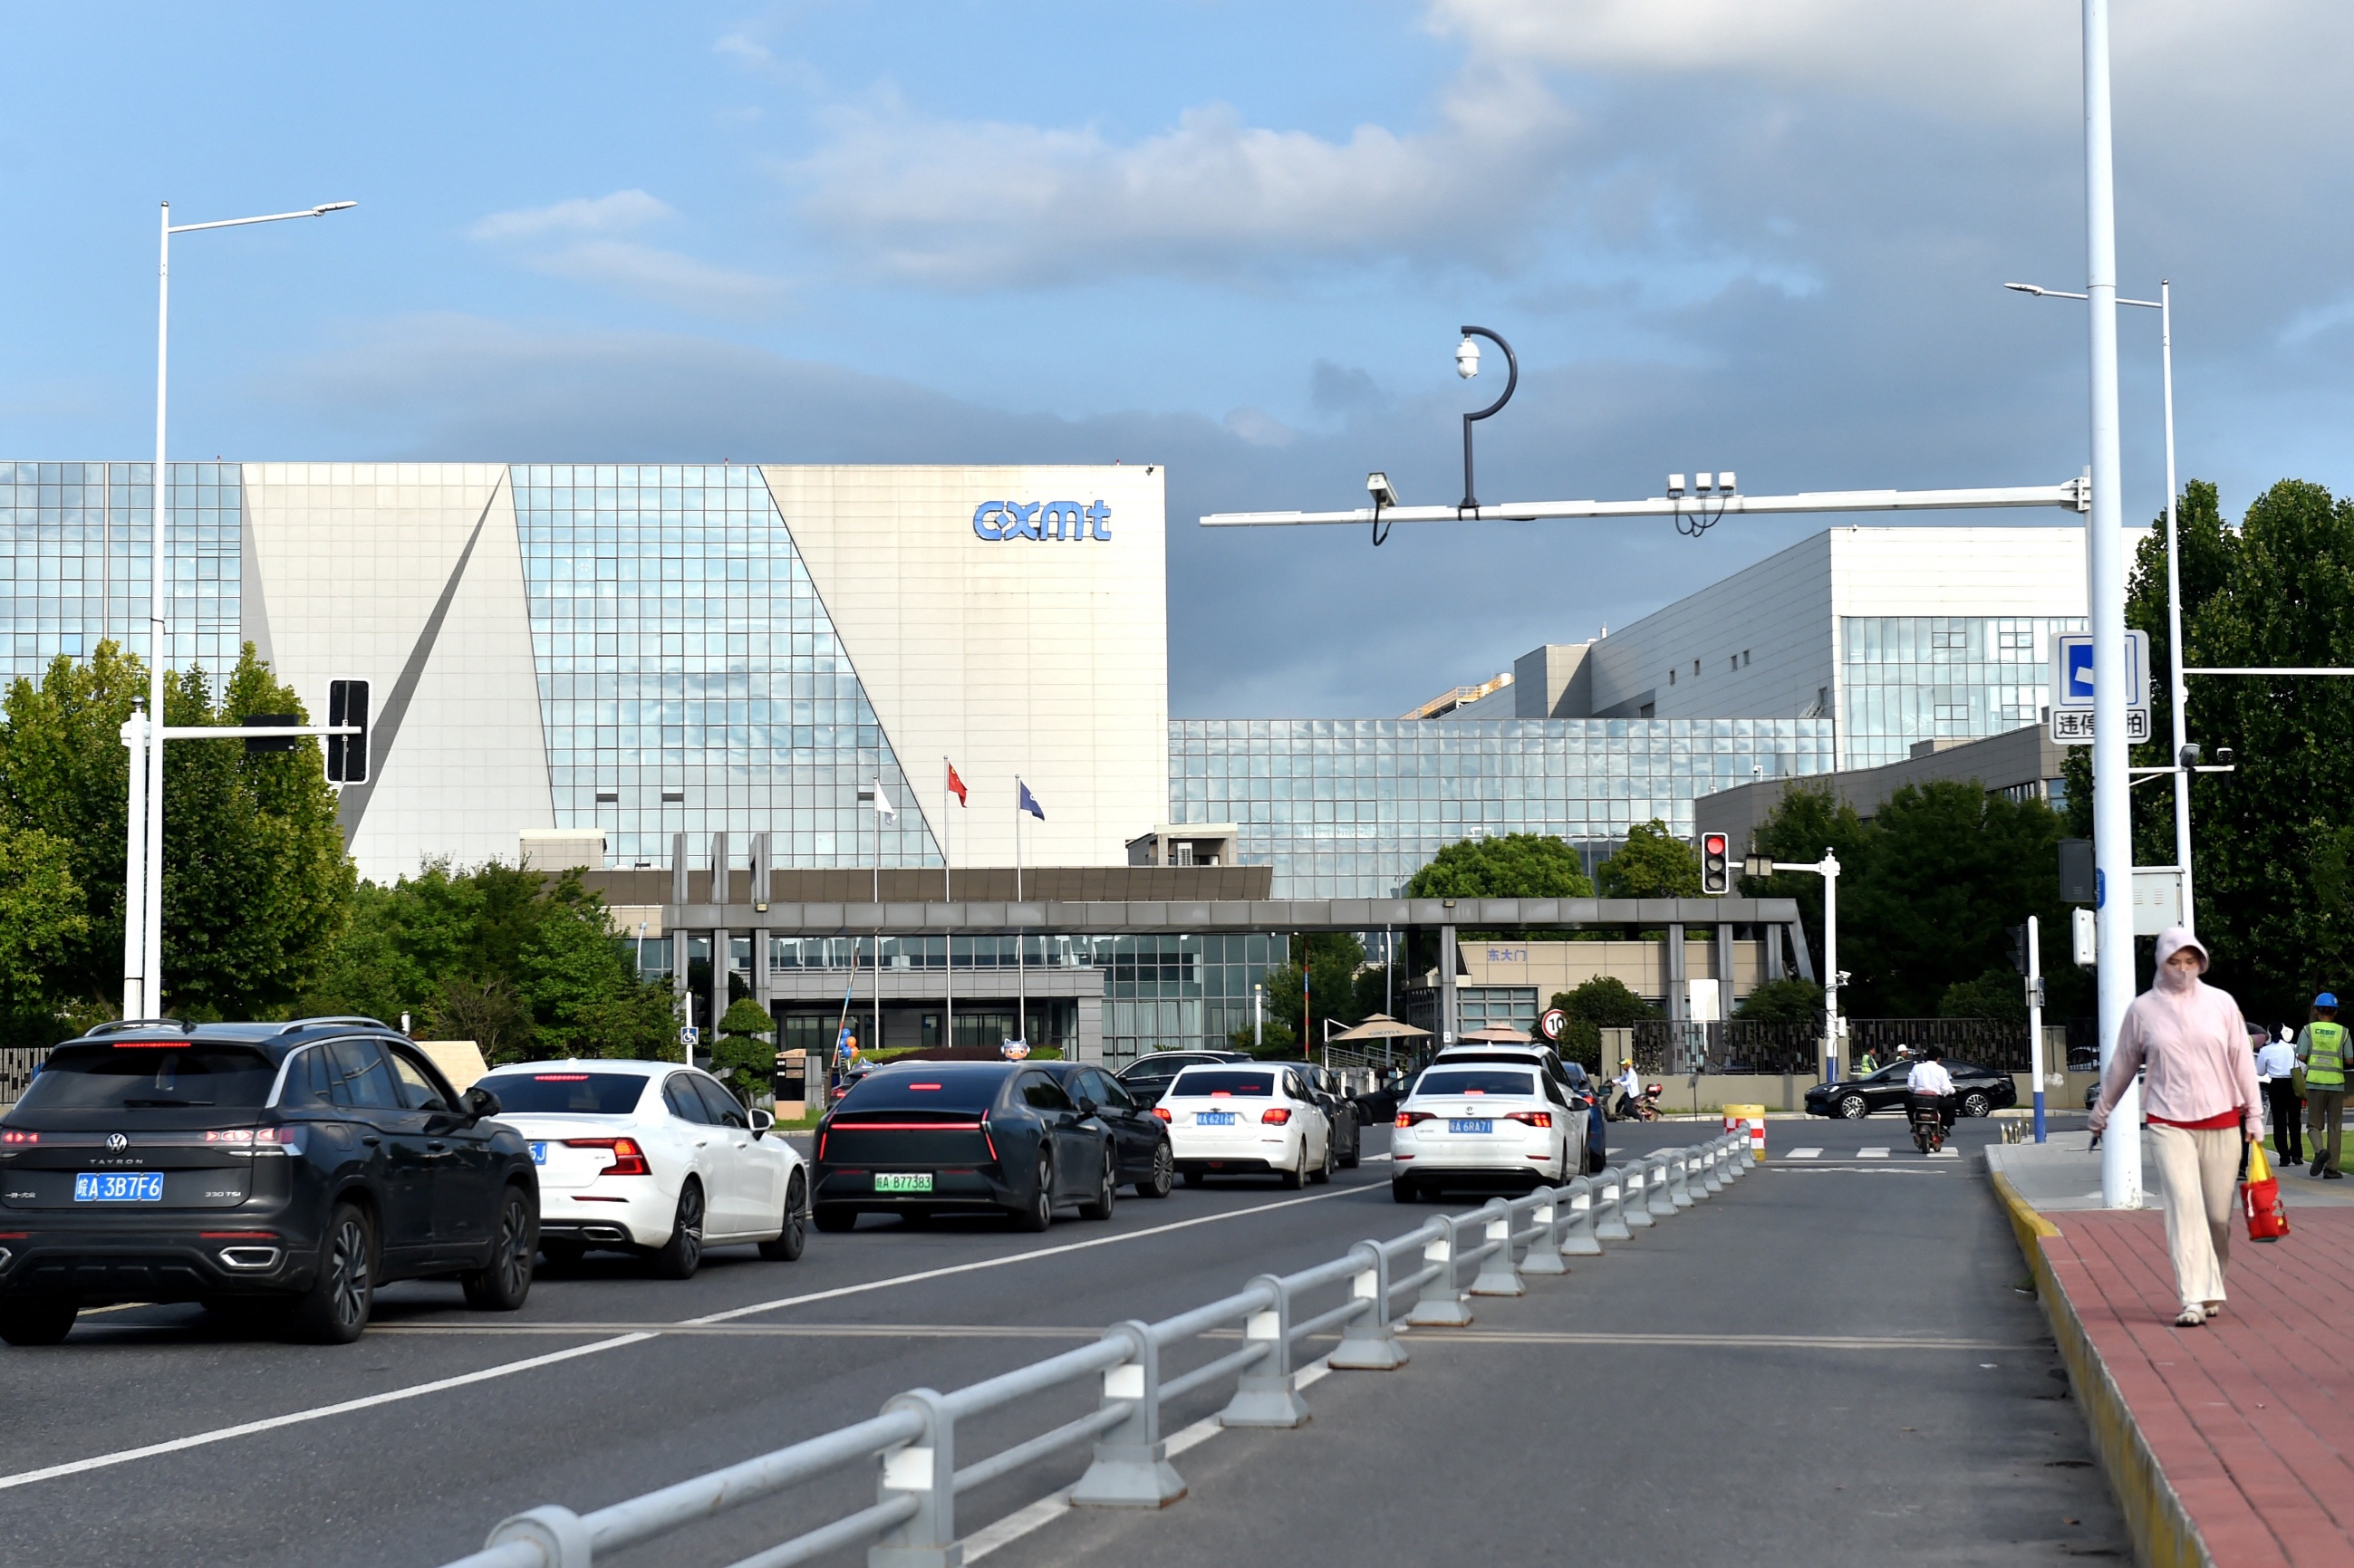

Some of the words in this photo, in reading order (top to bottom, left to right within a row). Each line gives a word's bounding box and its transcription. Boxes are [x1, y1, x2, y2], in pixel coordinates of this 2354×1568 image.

[2059, 713, 2143, 736] 违停拍
[1487, 948, 1527, 961] 东大门
[1548, 1017, 1565, 1031] 10
